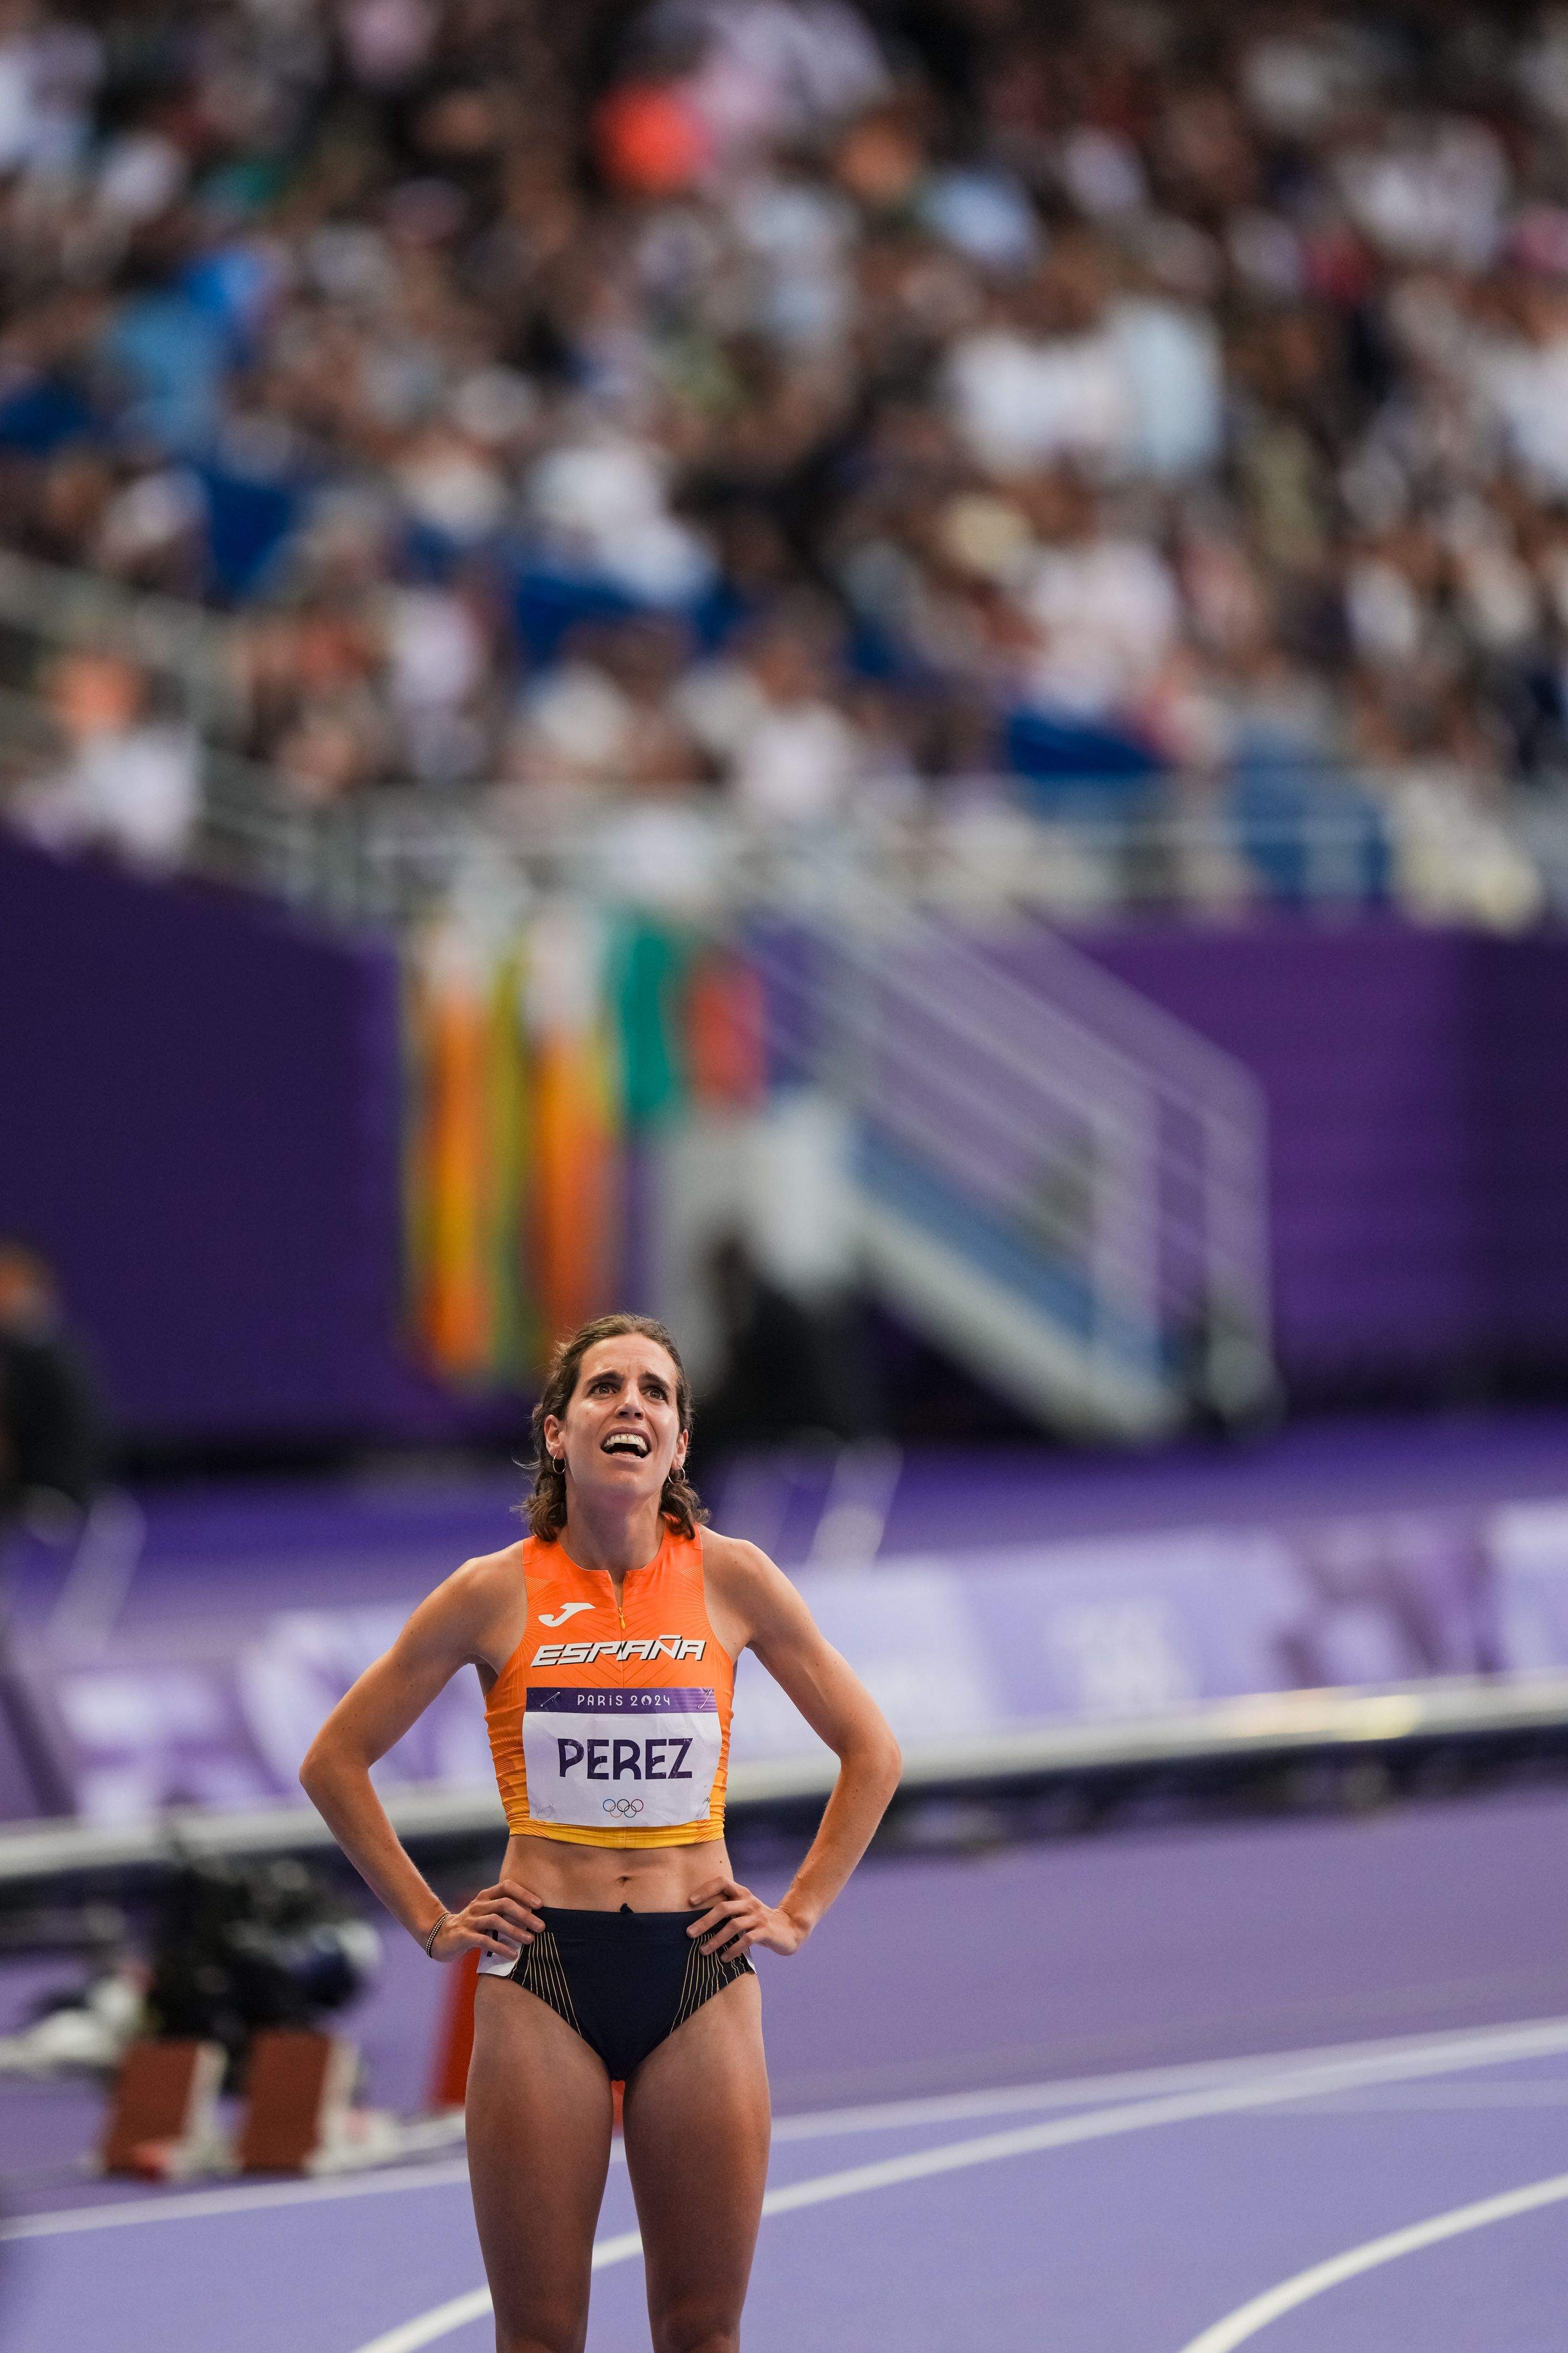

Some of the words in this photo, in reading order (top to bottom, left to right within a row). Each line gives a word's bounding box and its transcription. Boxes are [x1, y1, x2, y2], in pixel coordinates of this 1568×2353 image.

[530, 1634, 707, 1667] ESPAÑA
[630, 1694, 671, 1706] 2024
[557, 1737, 694, 1780] PEREZ
